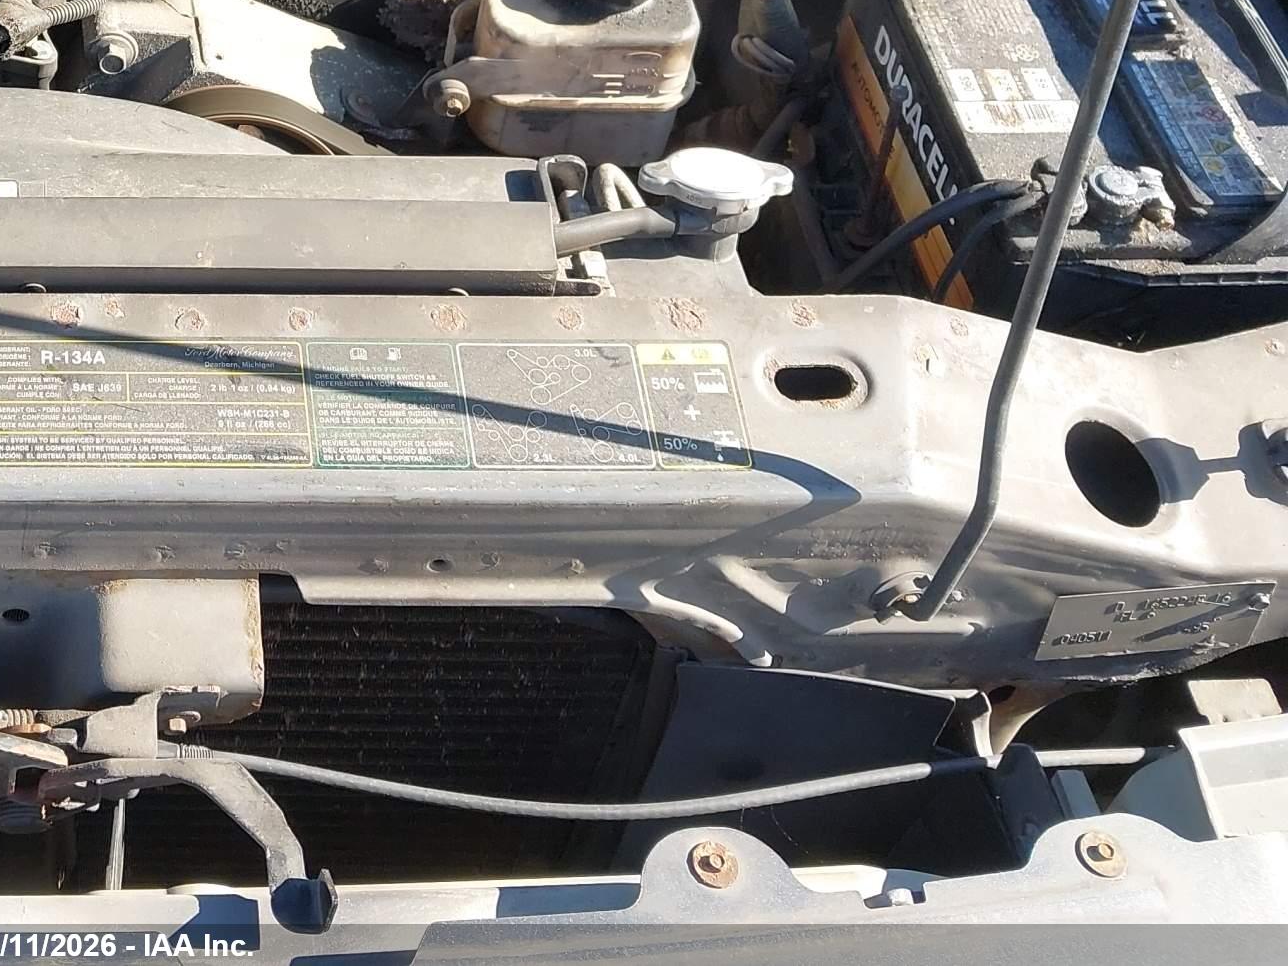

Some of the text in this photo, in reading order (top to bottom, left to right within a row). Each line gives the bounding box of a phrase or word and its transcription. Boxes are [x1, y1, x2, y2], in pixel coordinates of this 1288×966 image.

[40, 350, 106, 365] R-134A
[574, 349, 597, 358] 3.0L
[242, 361, 275, 370] Michigan
[71, 381, 122, 393] SAE J639
[211, 384, 216, 392] 2
[218, 384, 228, 392] lb
[281, 383, 296, 394] kg)
[651, 377, 685, 390] 50%
[663, 437, 698, 451] 50%
[533, 453, 555, 462] 2.3L
[618, 453, 641, 462] 4.0L
